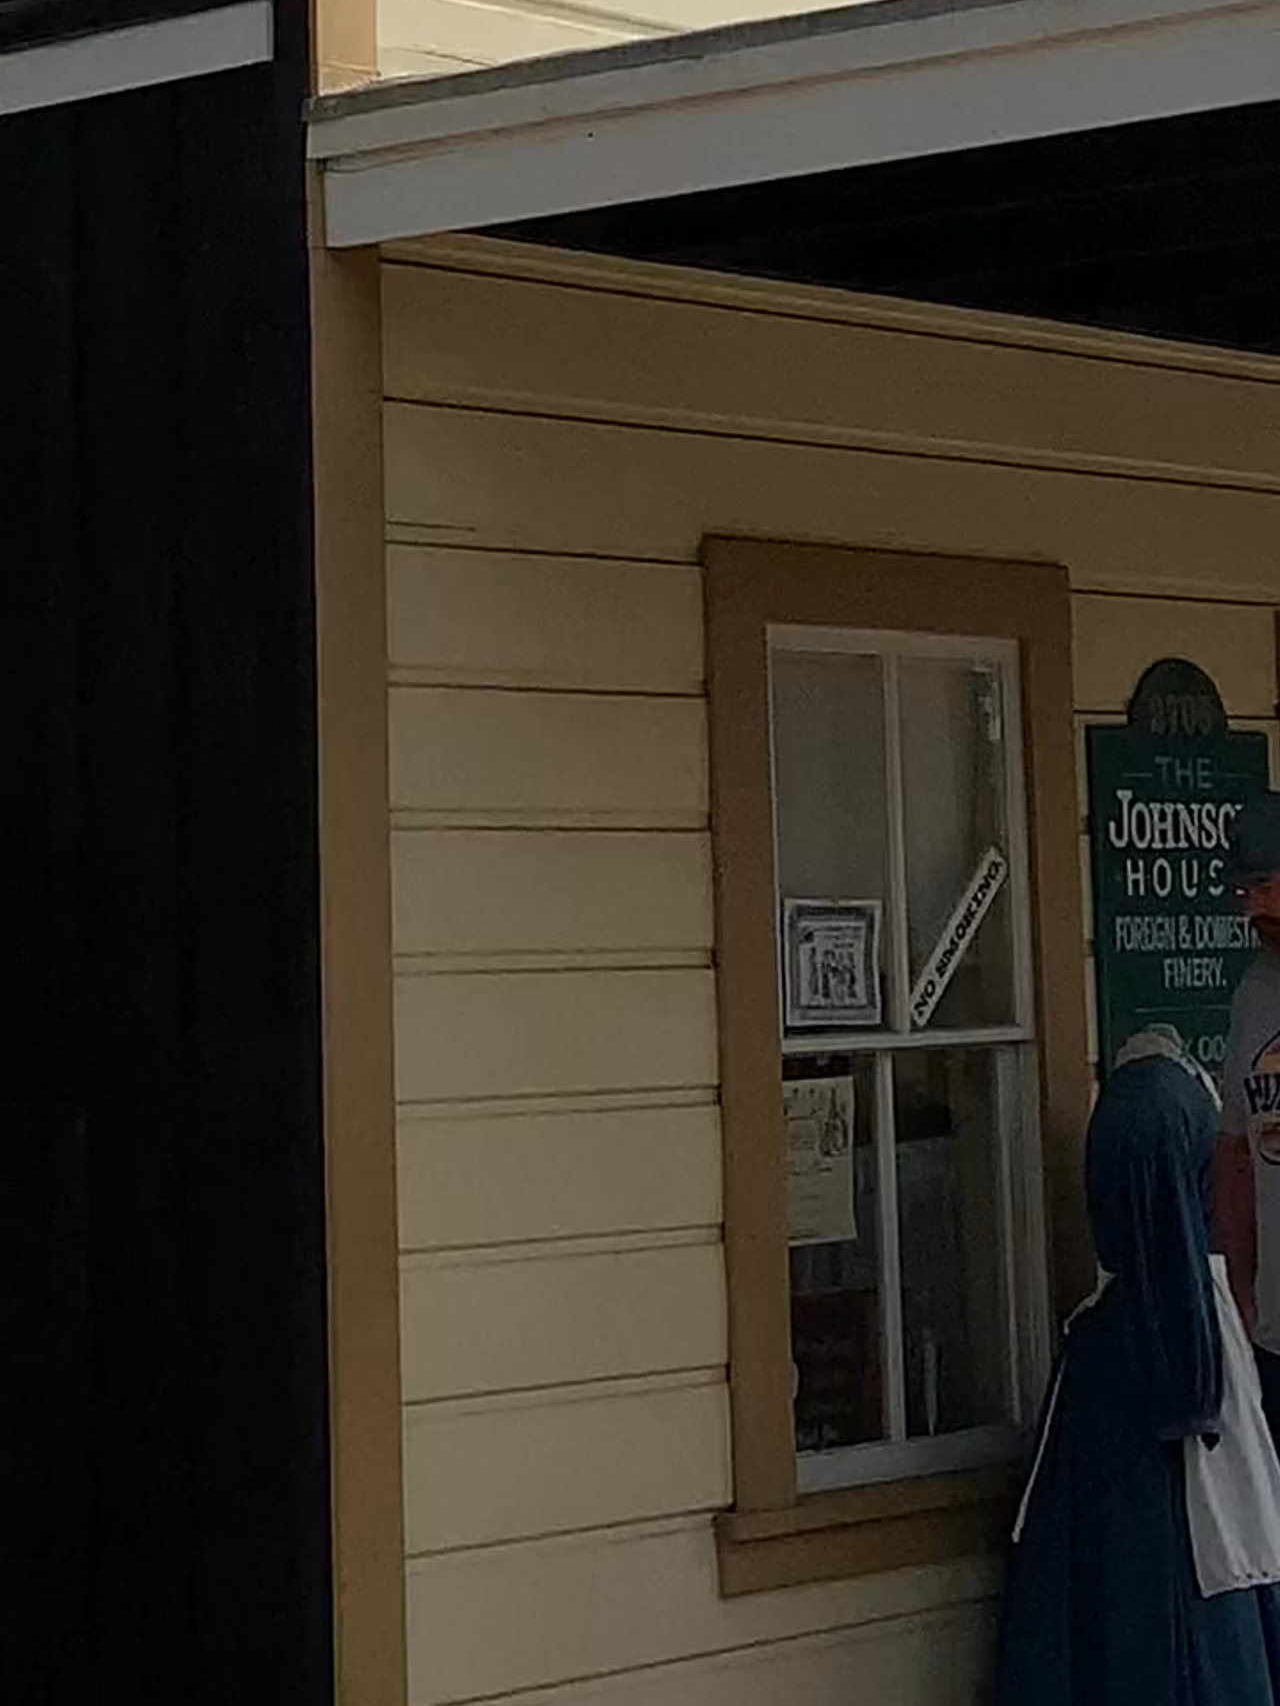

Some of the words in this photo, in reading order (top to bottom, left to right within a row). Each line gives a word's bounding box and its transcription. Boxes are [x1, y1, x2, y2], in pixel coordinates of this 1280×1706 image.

[1153, 755, 1213, 790] THE
[1108, 789, 1244, 850] JOHNSO
[1125, 857, 1244, 898] HOUS
[914, 979, 937, 1016] NO
[936, 860, 1003, 979] SMOKING
[1114, 916, 1175, 952] FOREIGN
[1178, 915, 1191, 949] &
[1163, 956, 1227, 989] FINERY.
